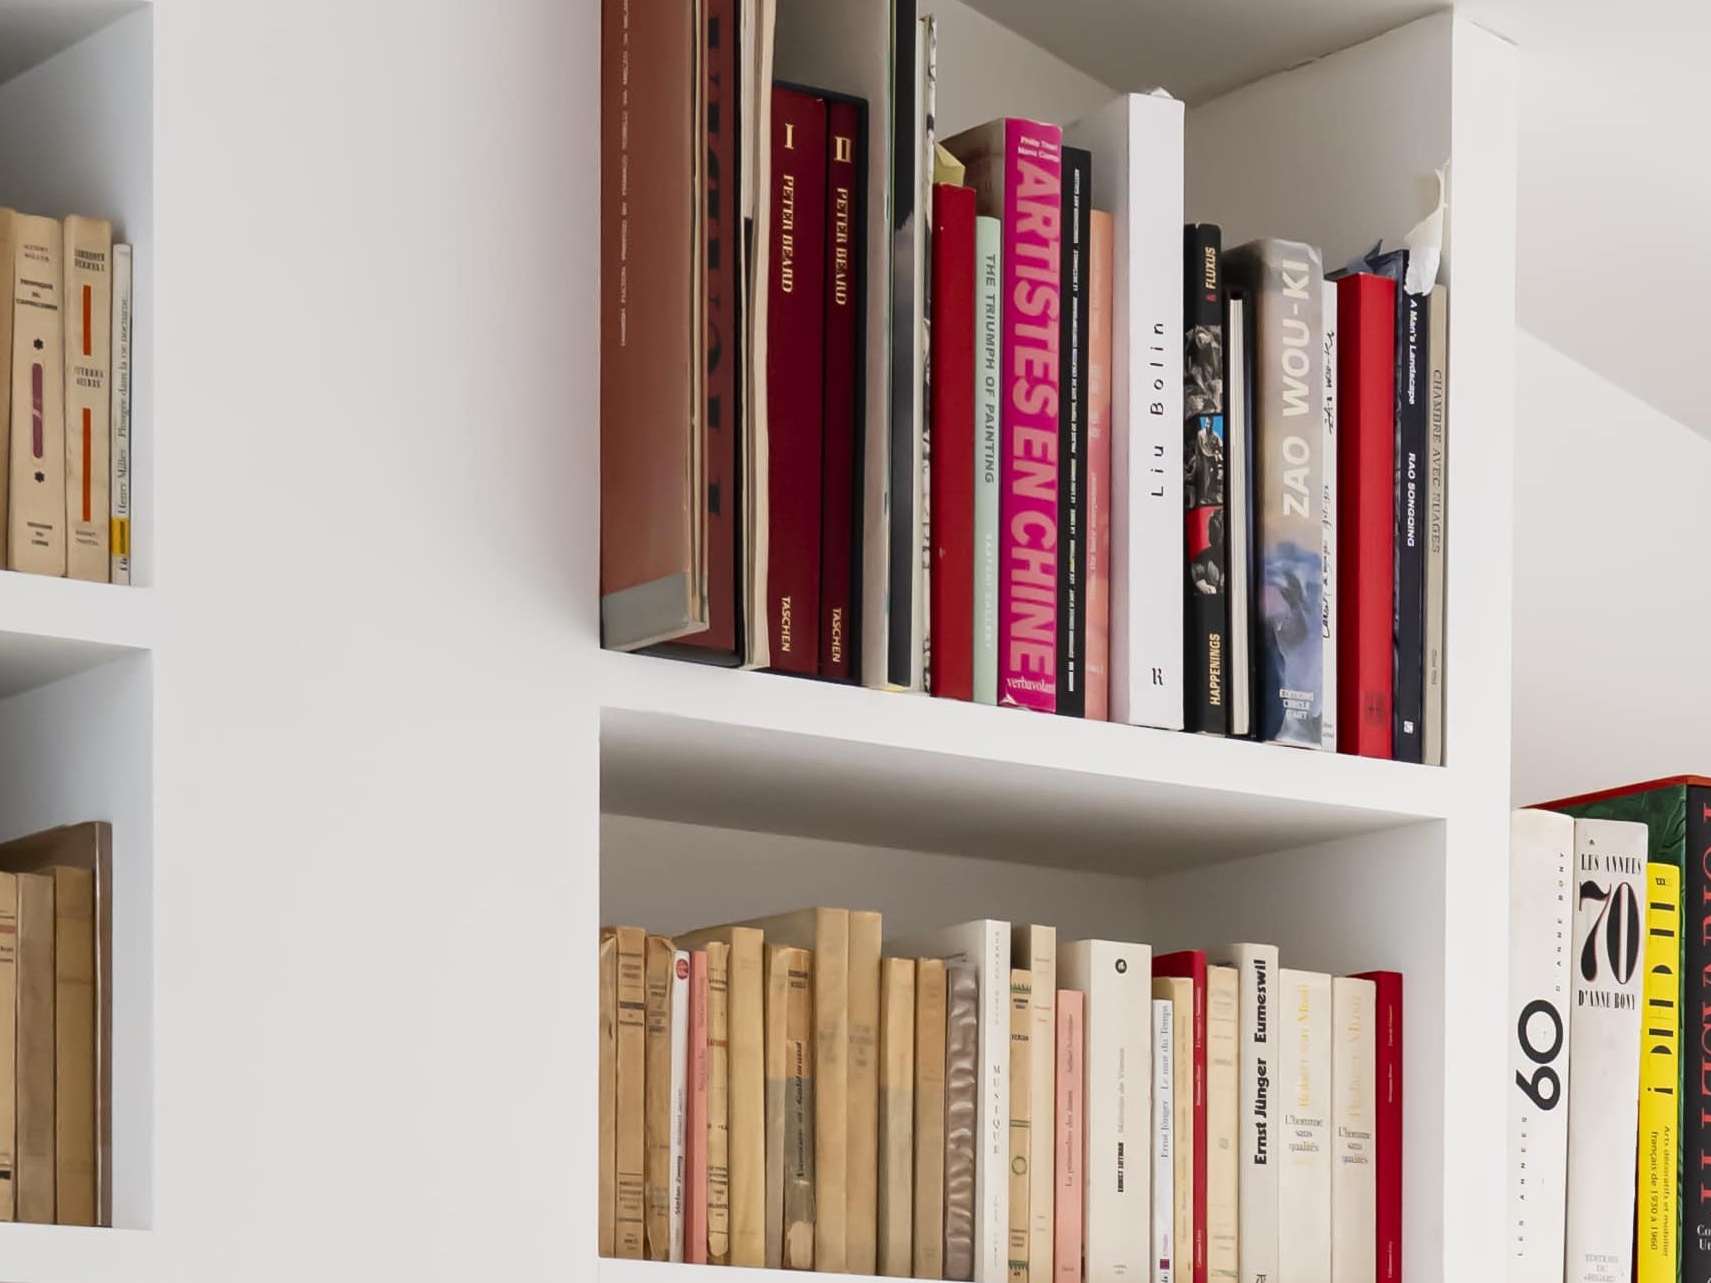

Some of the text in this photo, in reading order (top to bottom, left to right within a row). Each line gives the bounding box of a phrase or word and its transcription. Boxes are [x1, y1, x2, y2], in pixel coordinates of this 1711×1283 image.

[781, 175, 796, 293] PETER BEARD
[834, 188, 850, 306] PETER BEARD
[984, 254, 997, 484] THE TRIUMPH OF PAINTING
[1008, 158, 1061, 676] ARTISTES EN CHINE
[1151, 323, 1164, 497] Liu Bolin
[1281, 260, 1311, 519] ZAO WOU-KI
[1407, 452, 1417, 547] RAO SONGQING
[780, 596, 791, 652] TASCHEN
[831, 608, 842, 664] TASCHEN
[1579, 880, 1641, 985] 70
[1253, 959, 1271, 1166] Ernst Jünger Eumeswil
